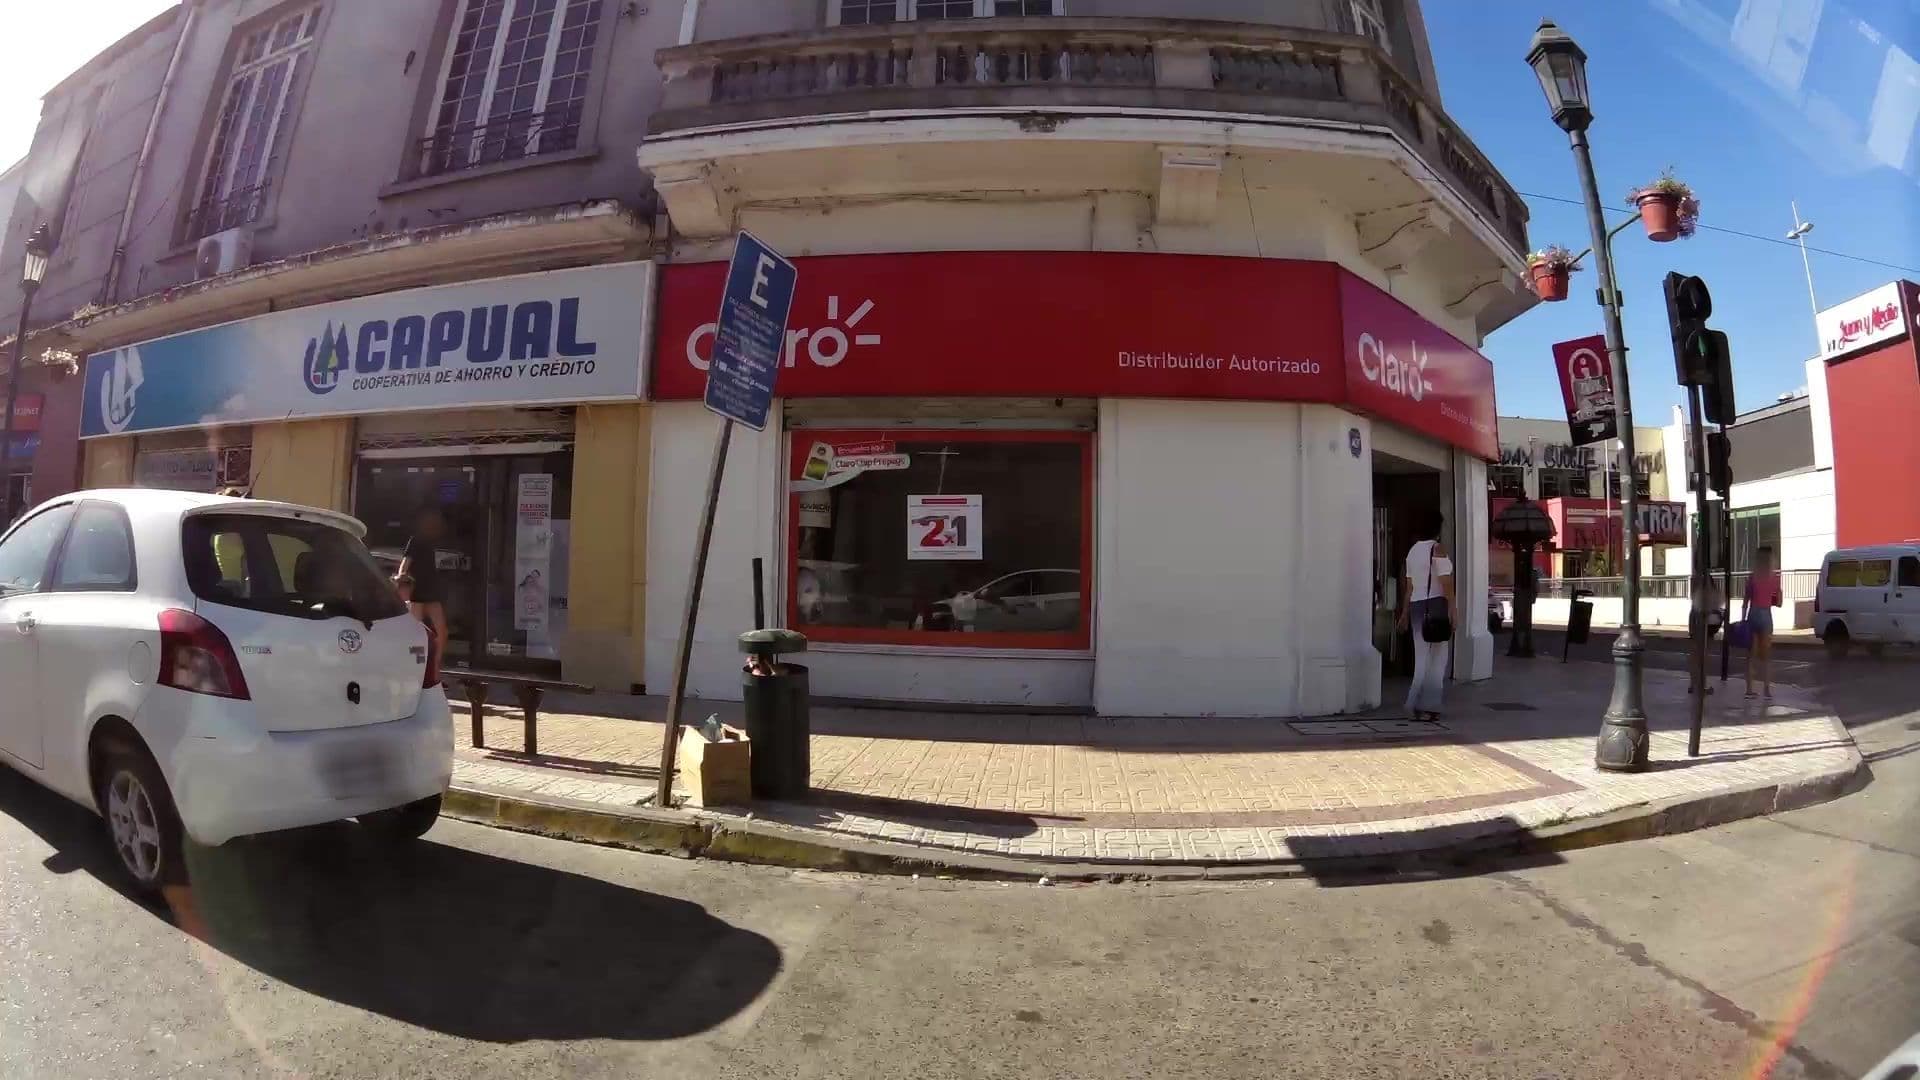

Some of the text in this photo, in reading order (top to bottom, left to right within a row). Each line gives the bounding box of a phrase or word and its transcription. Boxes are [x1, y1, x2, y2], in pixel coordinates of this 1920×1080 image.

[749, 251, 776, 309] E
[354, 296, 597, 374] CAPUAL
[1117, 351, 1321, 375] Distribuidor Autorizado
[352, 359, 596, 391] COOPERATIVA DE AHORRO Y CRÉDITO
[1358, 332, 1424, 403] Claro
